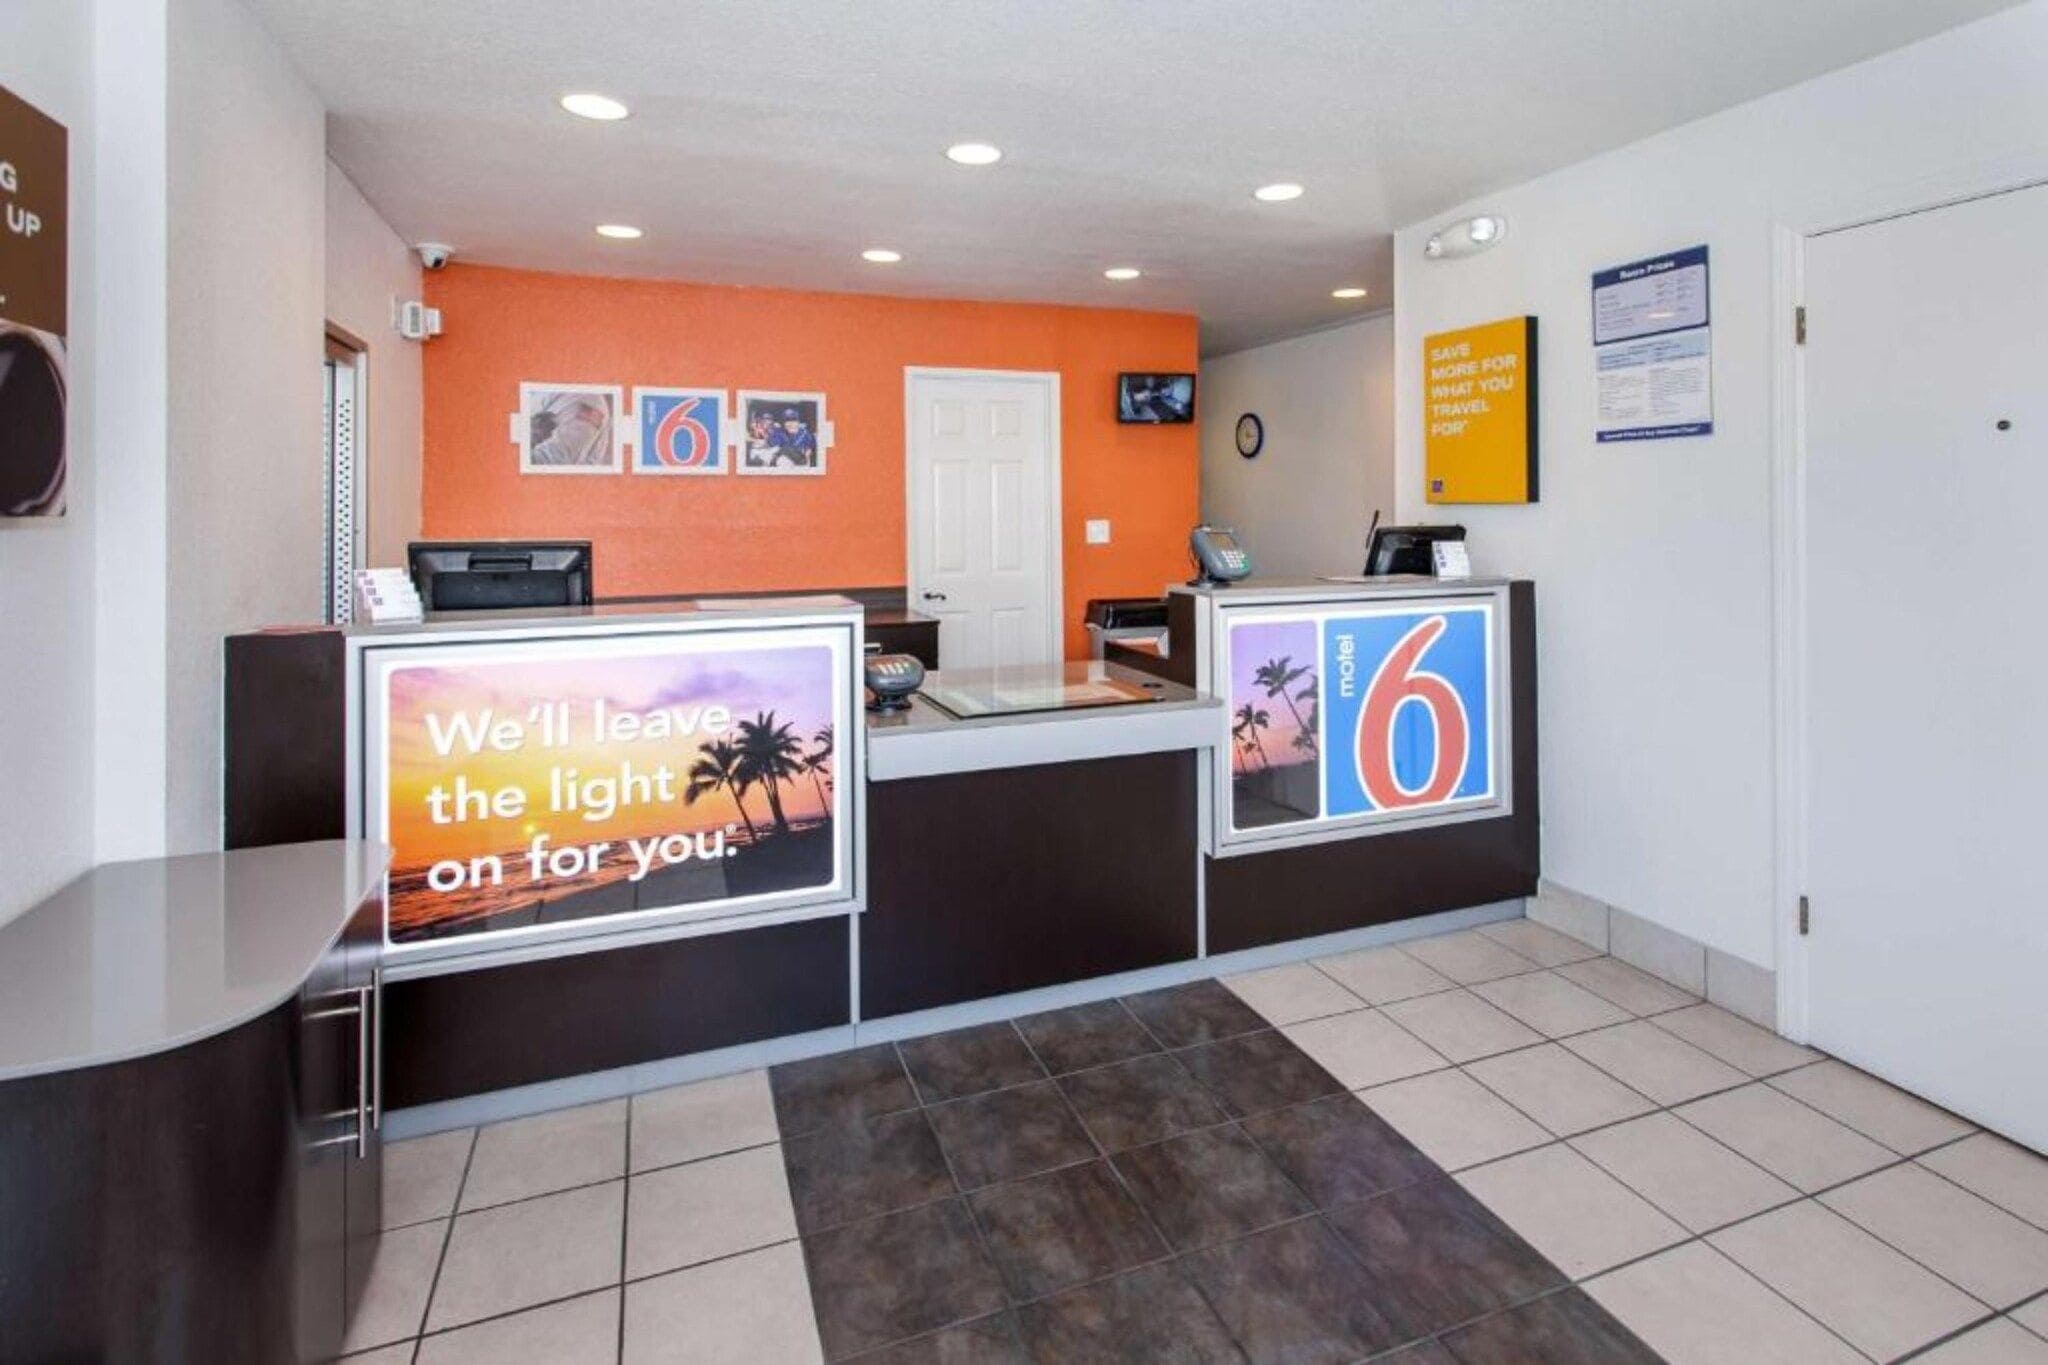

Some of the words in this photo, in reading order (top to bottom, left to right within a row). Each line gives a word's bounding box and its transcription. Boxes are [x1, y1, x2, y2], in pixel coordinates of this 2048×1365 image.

[7, 204, 42, 238] UP
[1432, 343, 1471, 361] SAVE
[1432, 361, 1479, 380] MORE
[1482, 353, 1518, 372] FOR
[1432, 381, 1473, 399] WHAT
[1479, 376, 1514, 393] YOU
[1432, 399, 1491, 416] TRAVEL
[655, 397, 710, 467] 6
[425, 701, 570, 757] We'll
[595, 697, 731, 743] leave
[1336, 634, 1354, 698] motel
[1354, 614, 1470, 812] 6
[425, 775, 526, 824] the
[550, 761, 675, 821] light
[427, 854, 502, 892] on
[526, 833, 610, 881] for
